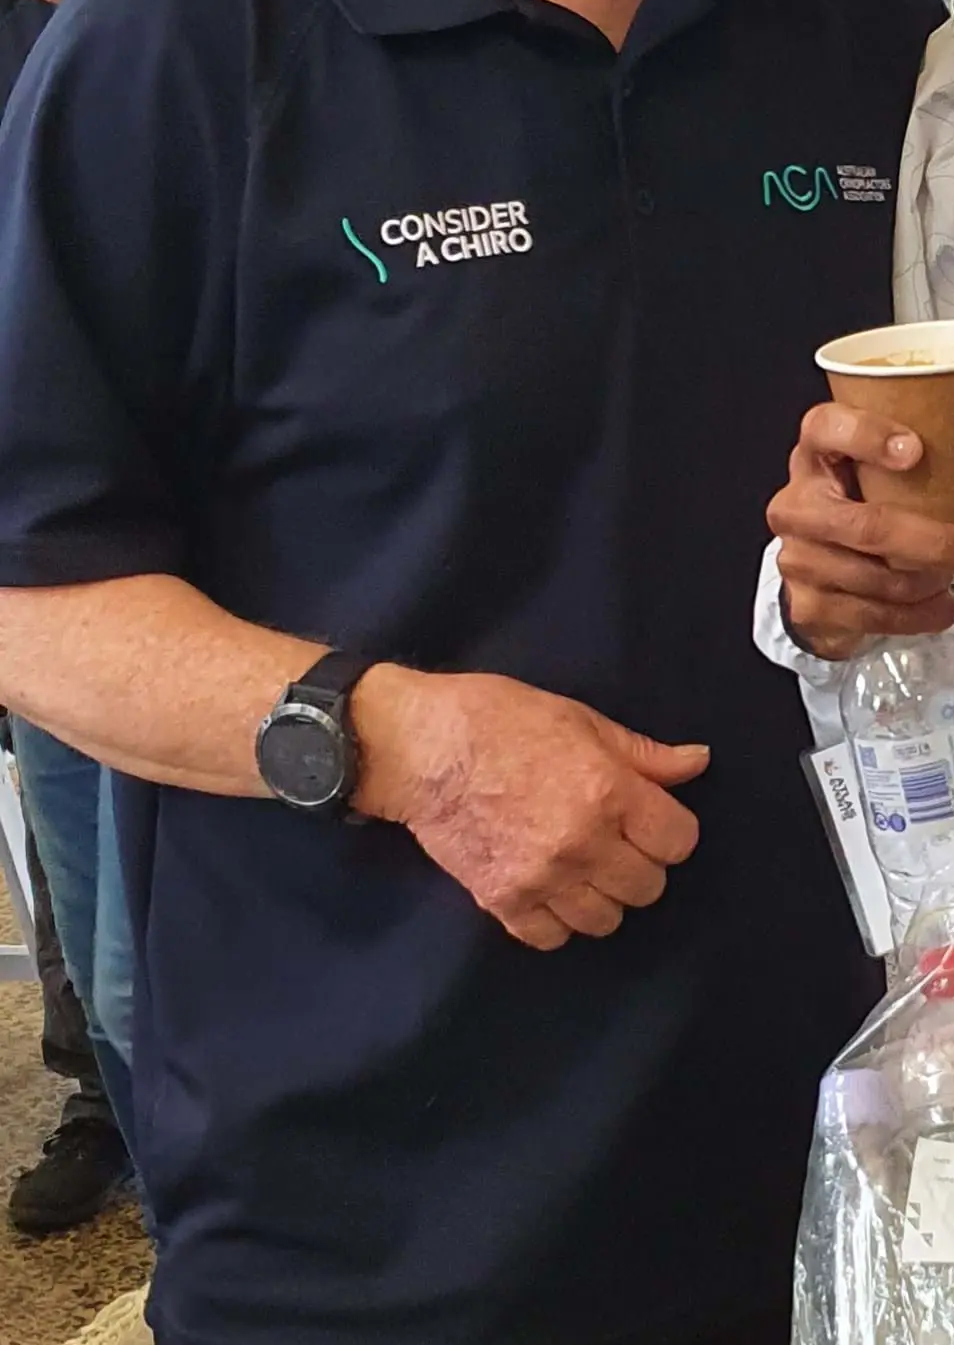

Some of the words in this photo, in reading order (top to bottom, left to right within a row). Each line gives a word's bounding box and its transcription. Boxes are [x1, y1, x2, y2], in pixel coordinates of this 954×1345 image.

[380, 200, 529, 245] CONSIDER
[416, 241, 440, 268] A
[440, 227, 533, 262] CHIRO
